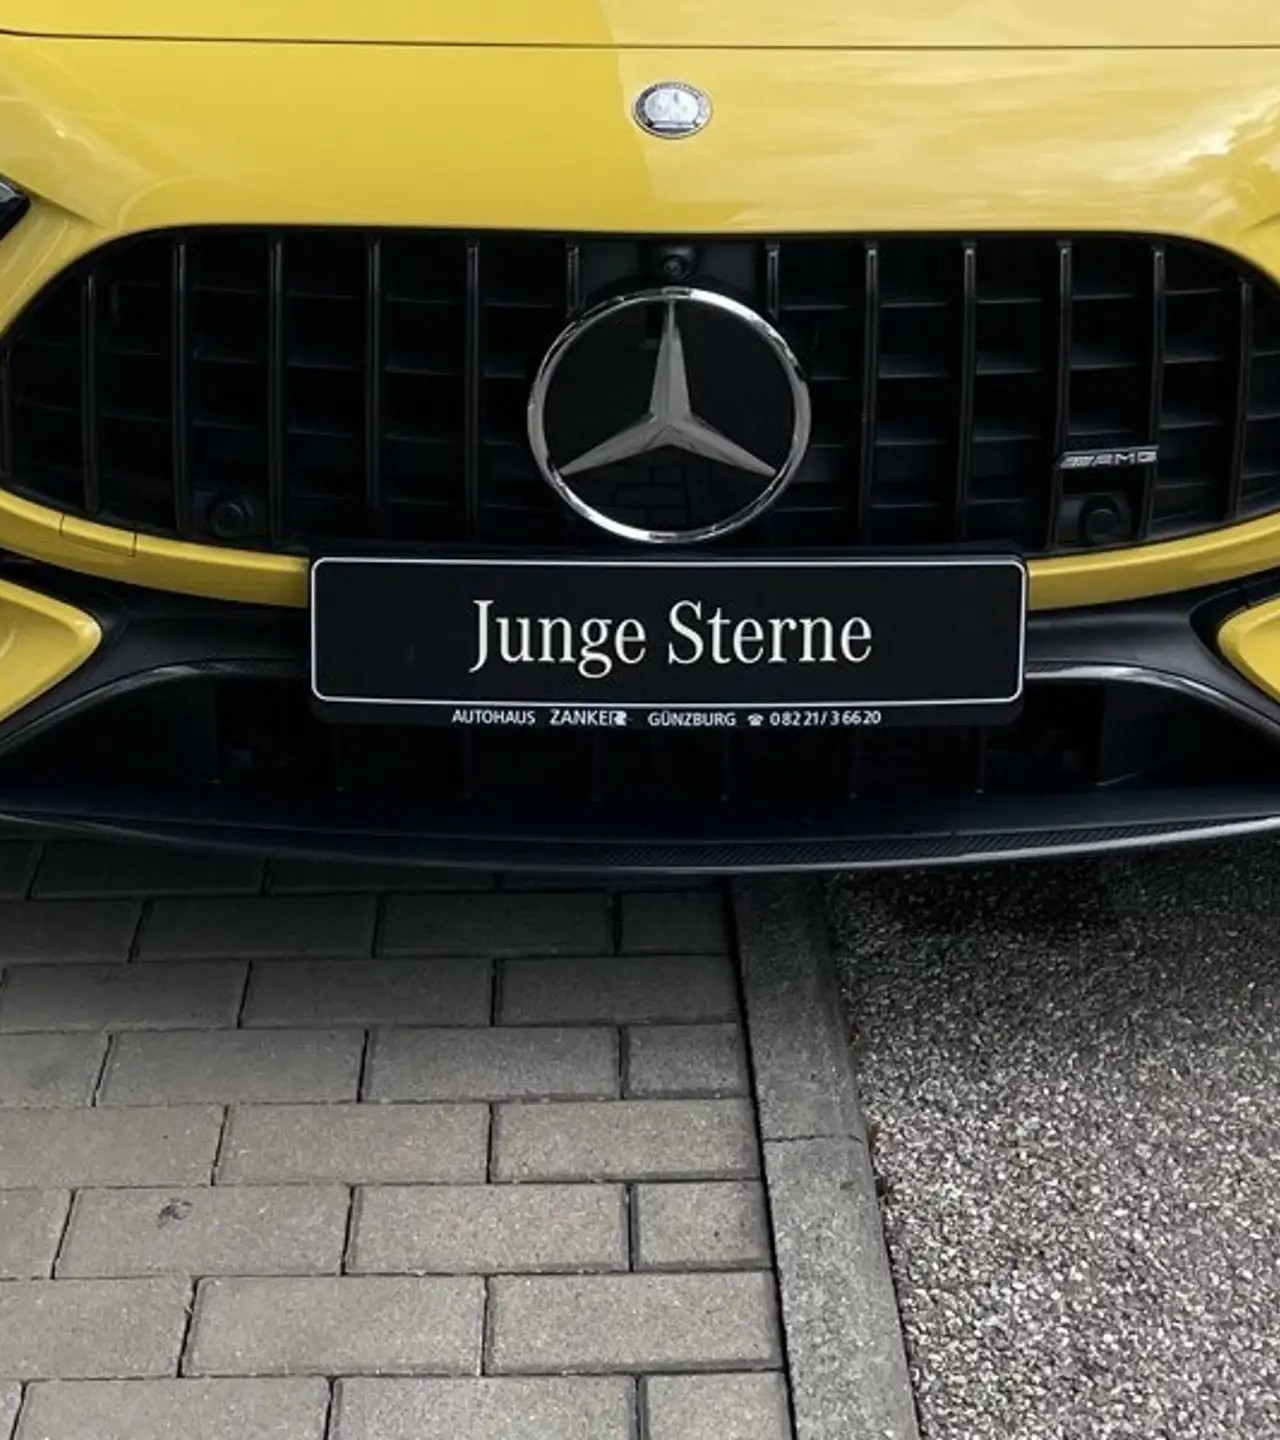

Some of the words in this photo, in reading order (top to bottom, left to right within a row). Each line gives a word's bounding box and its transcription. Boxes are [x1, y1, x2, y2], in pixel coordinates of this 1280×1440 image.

[468, 599, 646, 679] Junge
[668, 600, 872, 665] Sterne
[451, 709, 536, 726] AUTOHAUS
[549, 709, 627, 726] ZANKER
[647, 709, 737, 726] GÜNZBURG
